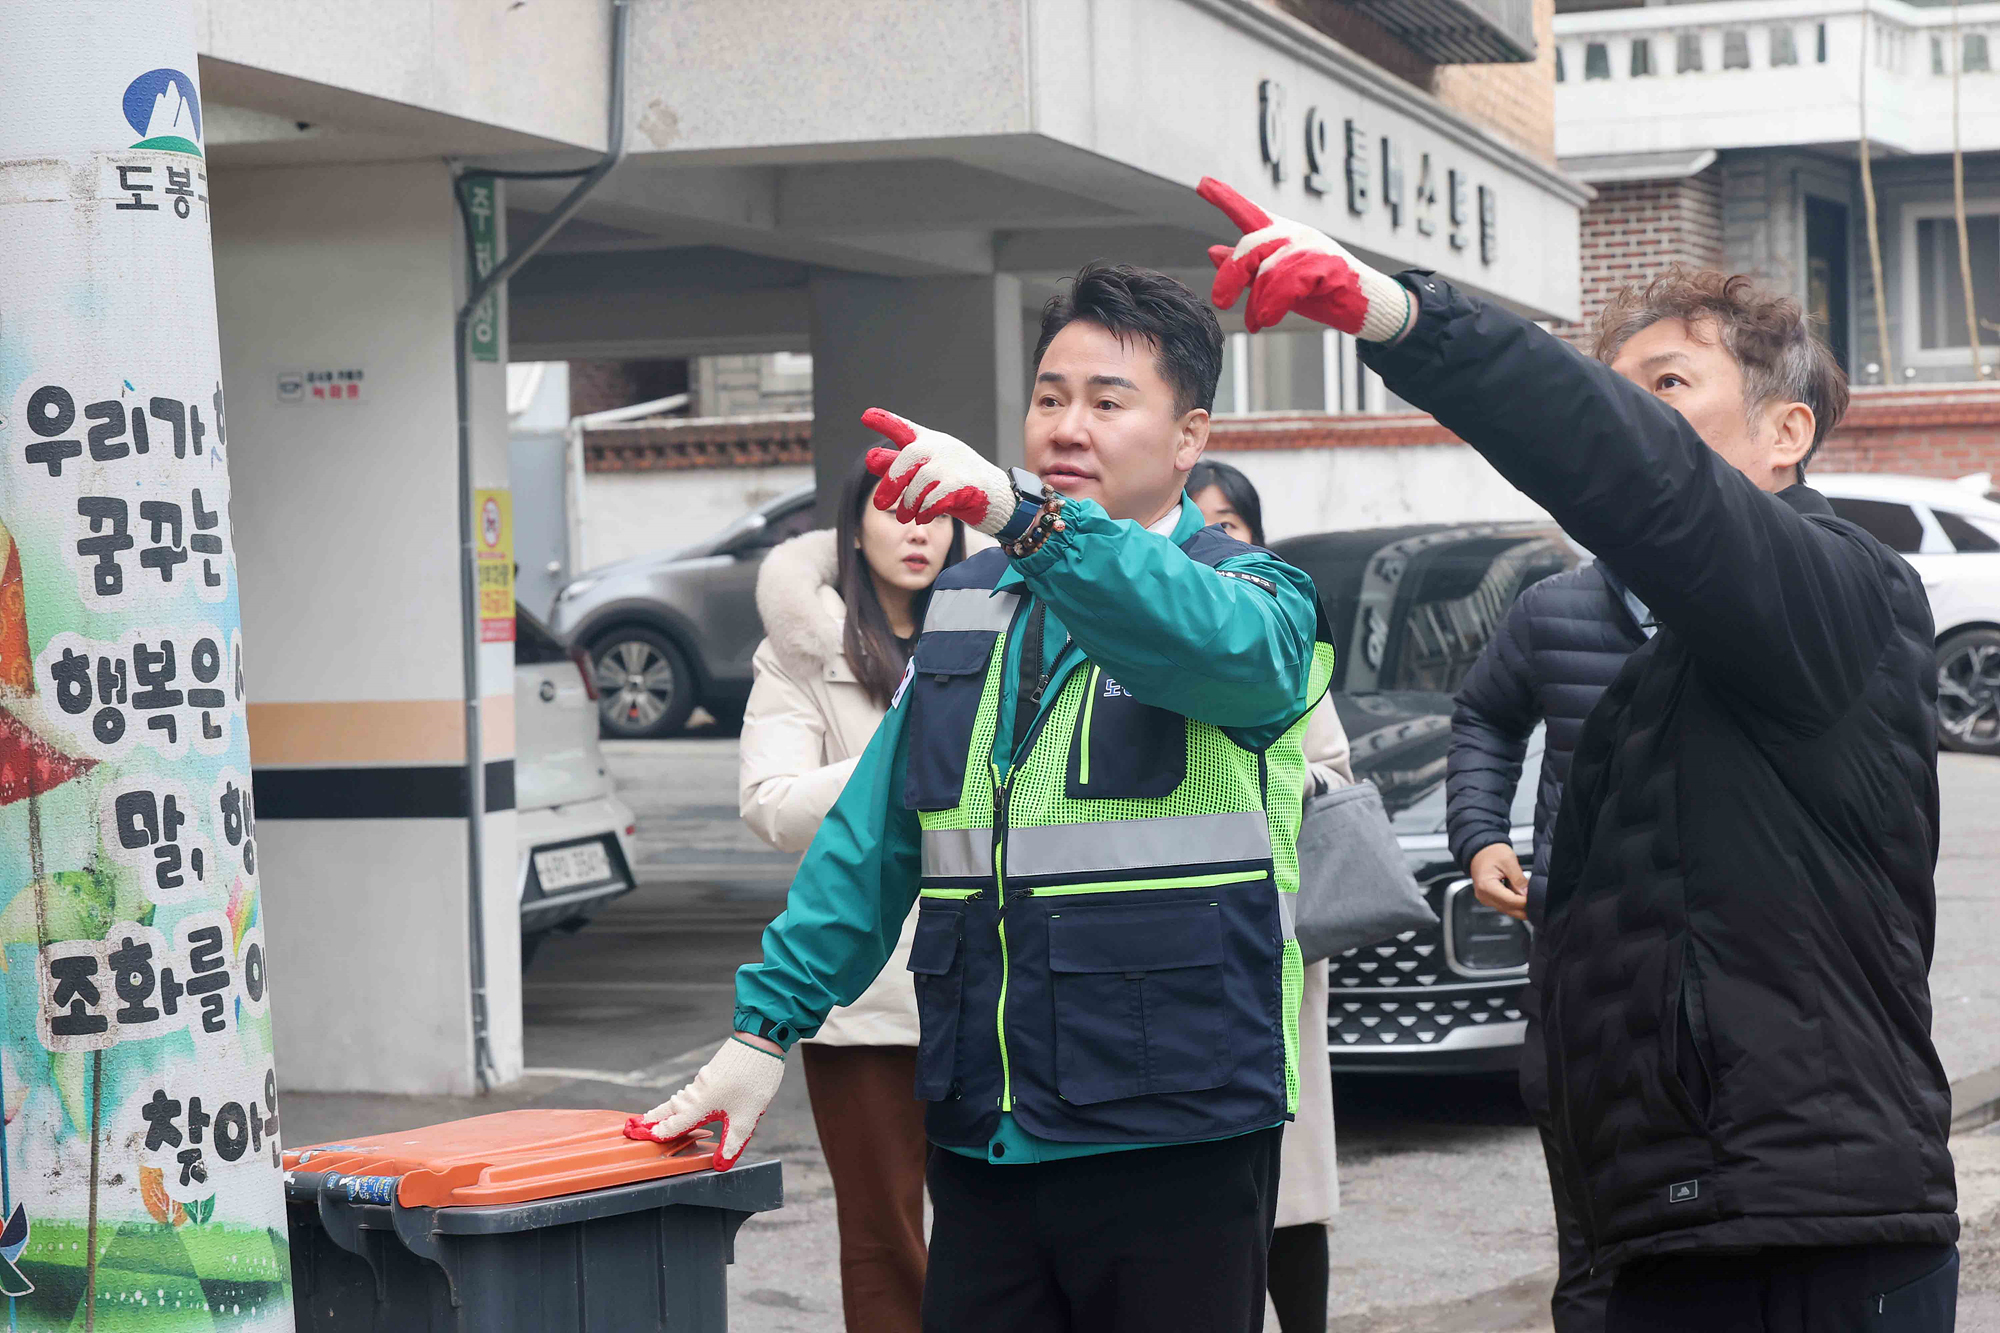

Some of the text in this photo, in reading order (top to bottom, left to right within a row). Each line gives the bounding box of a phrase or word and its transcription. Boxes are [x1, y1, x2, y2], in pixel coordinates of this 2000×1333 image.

[25, 386, 205, 477] 우리가
[77, 488, 223, 596] 꿈꾸는
[51, 636, 226, 744] 행복은
[115, 780, 257, 890] 말, 행
[50, 925, 231, 1036] 조화를
